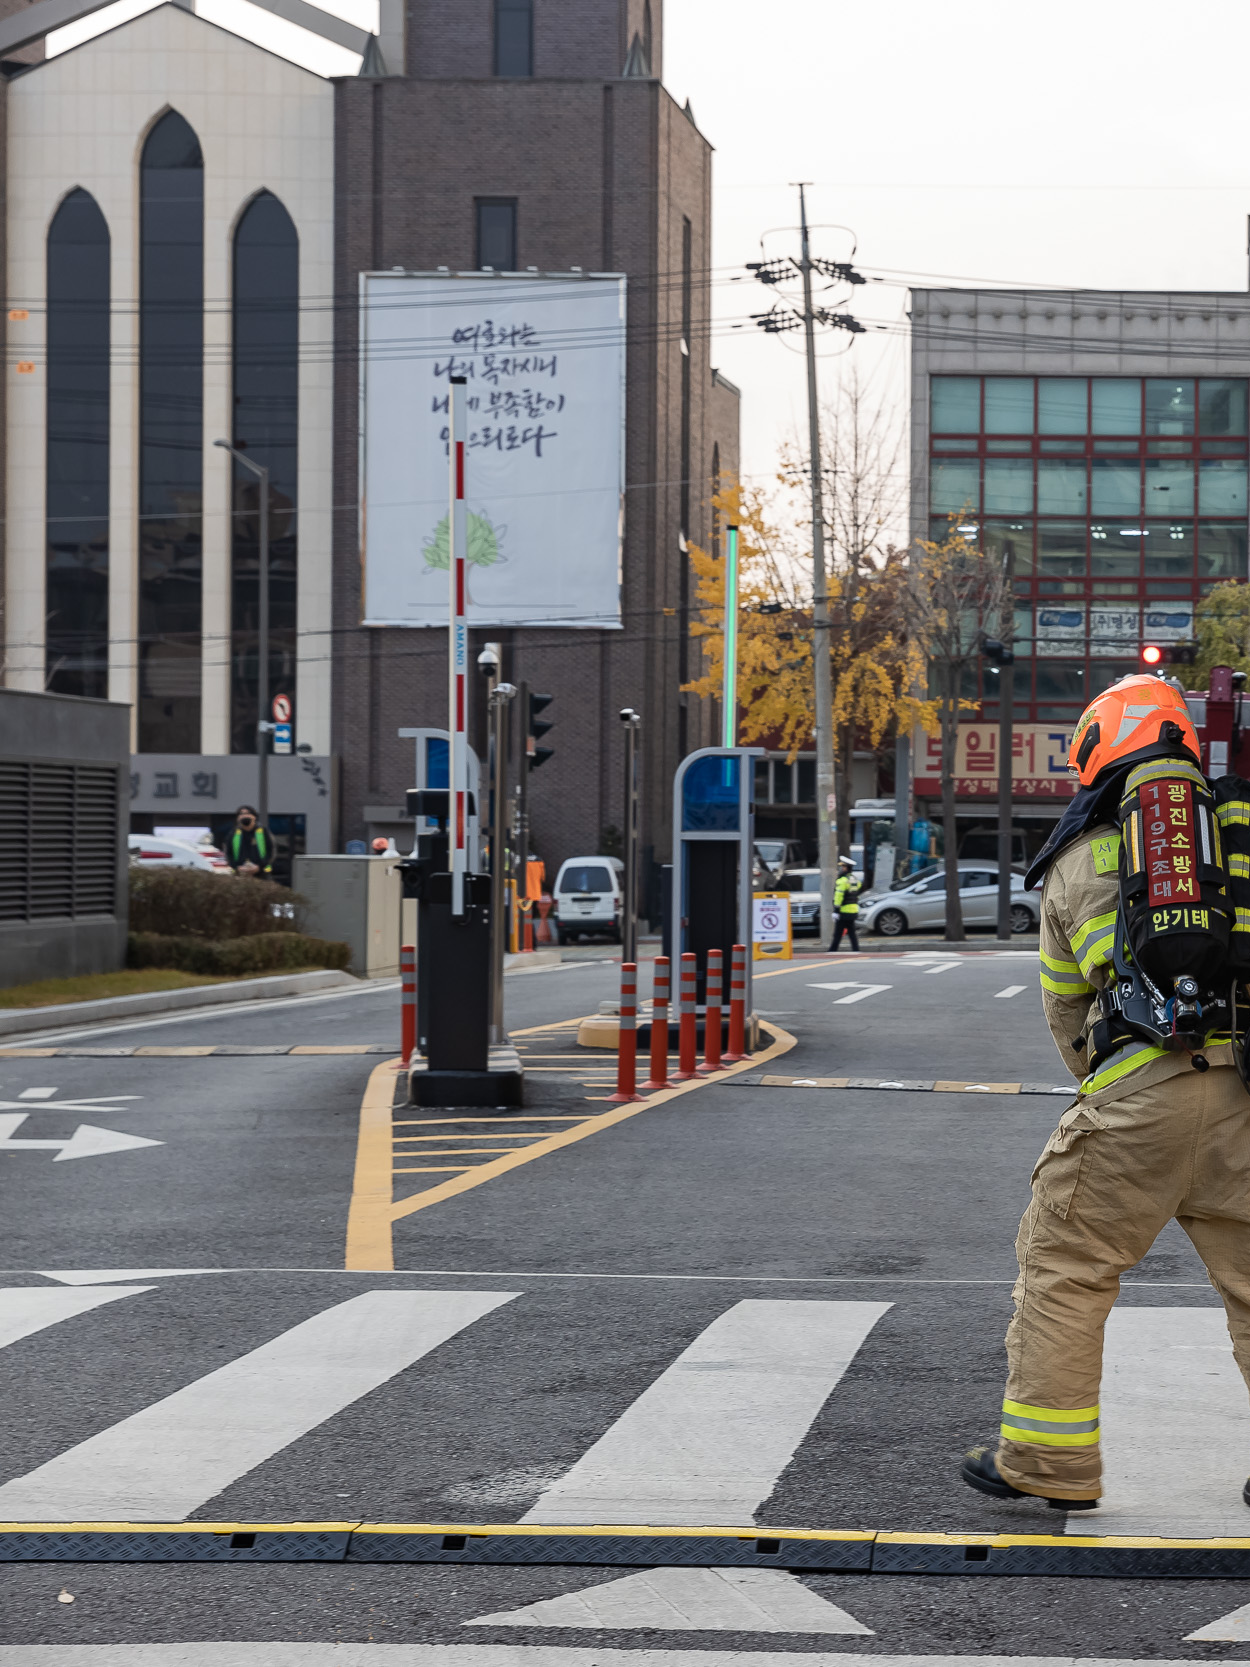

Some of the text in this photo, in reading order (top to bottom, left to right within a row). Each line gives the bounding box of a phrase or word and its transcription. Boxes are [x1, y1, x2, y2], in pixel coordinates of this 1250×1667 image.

[452, 319, 542, 352] 여호와는
[481, 353, 557, 386] 목자시니
[483, 388, 565, 420] 부족함이
[456, 623, 465, 666] AMANO
[1146, 785, 1172, 898] 119구조대
[1167, 783, 1194, 897] 광진소방서
[1152, 908, 1210, 932] 안기태
